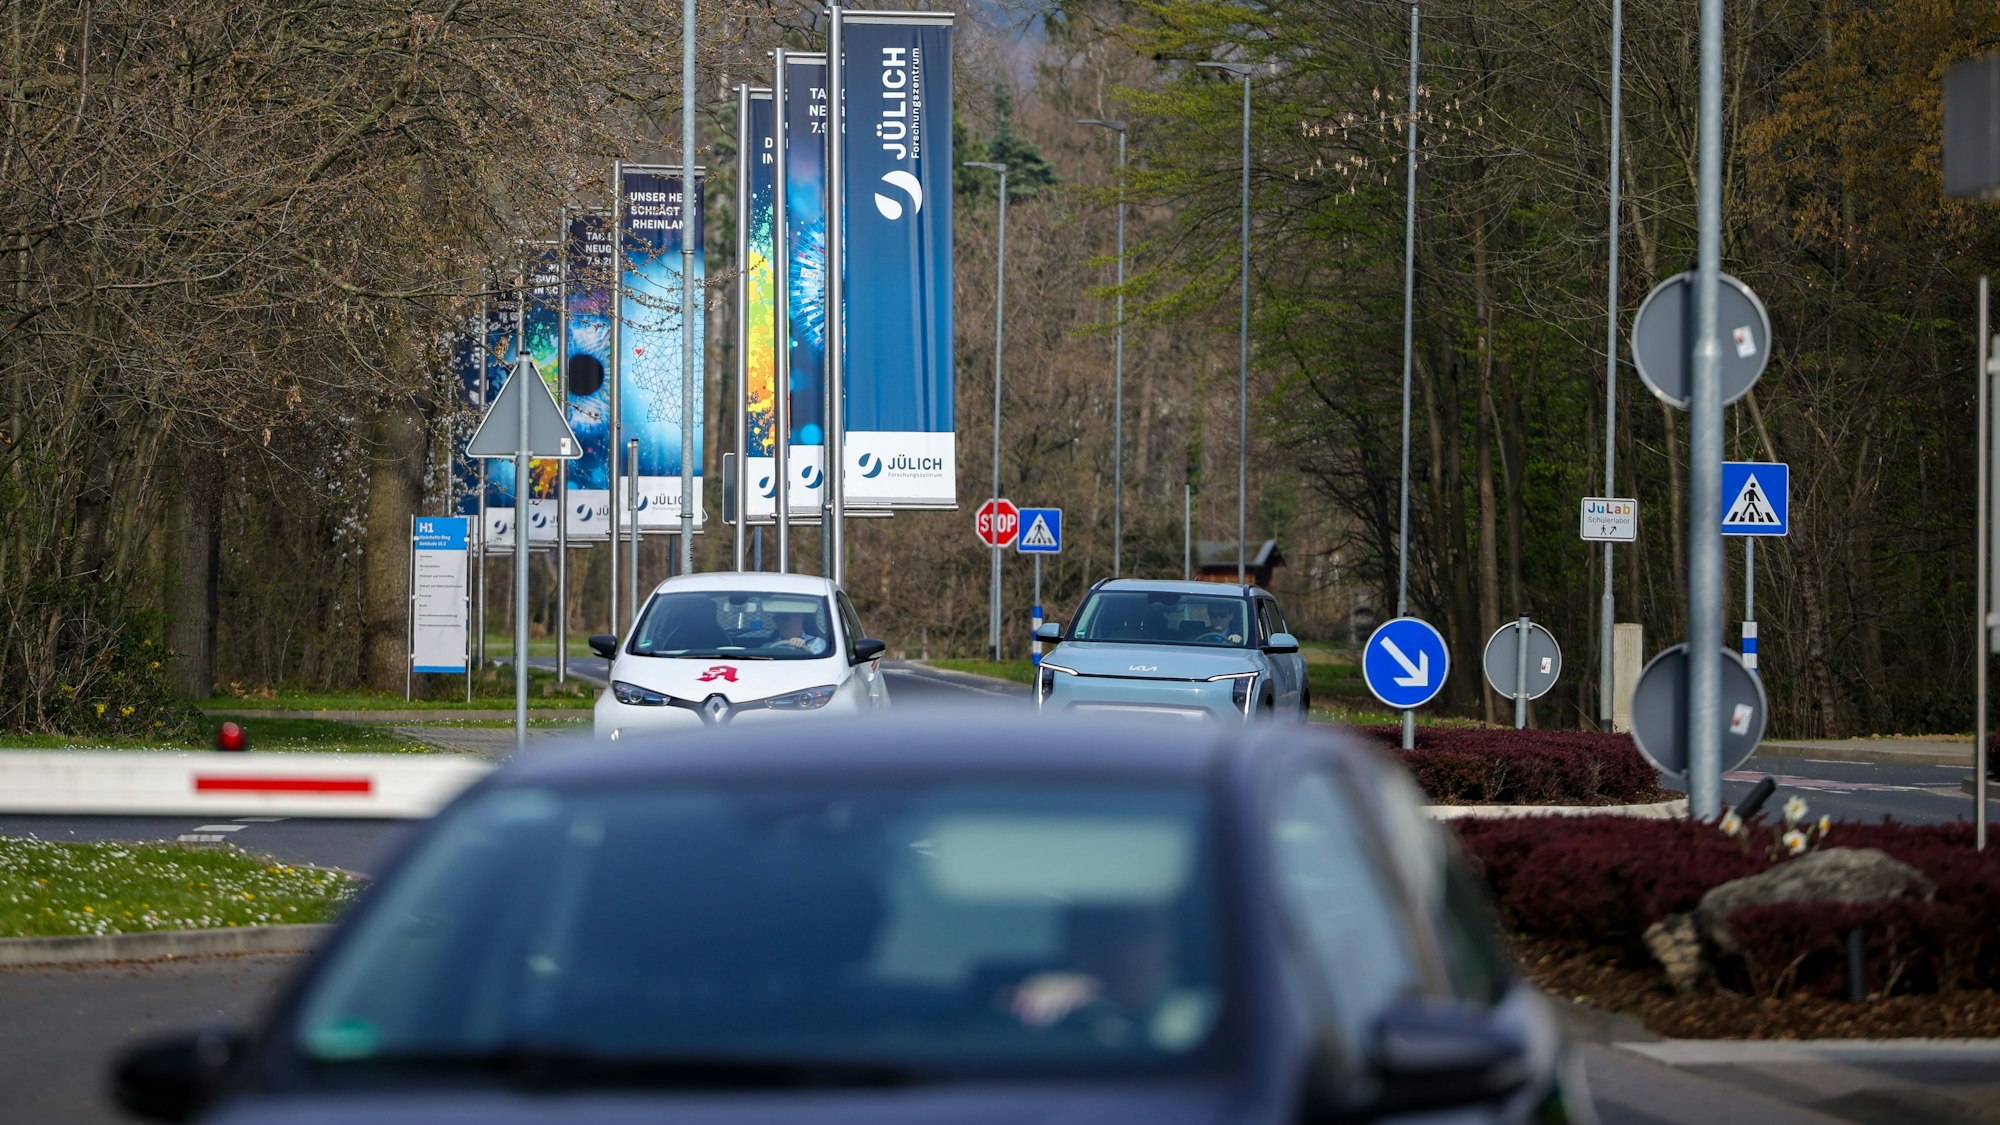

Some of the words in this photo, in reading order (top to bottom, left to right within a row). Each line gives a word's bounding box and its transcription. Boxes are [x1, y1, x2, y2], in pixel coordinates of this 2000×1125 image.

[809, 88, 827, 99] TA
[876, 47, 907, 160] JÜLICH
[911, 47, 922, 159] Forschungszentrum
[630, 191, 666, 202] UNSER
[630, 204, 680, 216] SCHLÄGT
[887, 454, 942, 470] JÜLICH
[652, 493, 683, 505] JÜLIC
[1587, 502, 1631, 515] JuLab
[1587, 515, 1631, 524] Schülerlabor
[419, 522, 434, 533] H1
